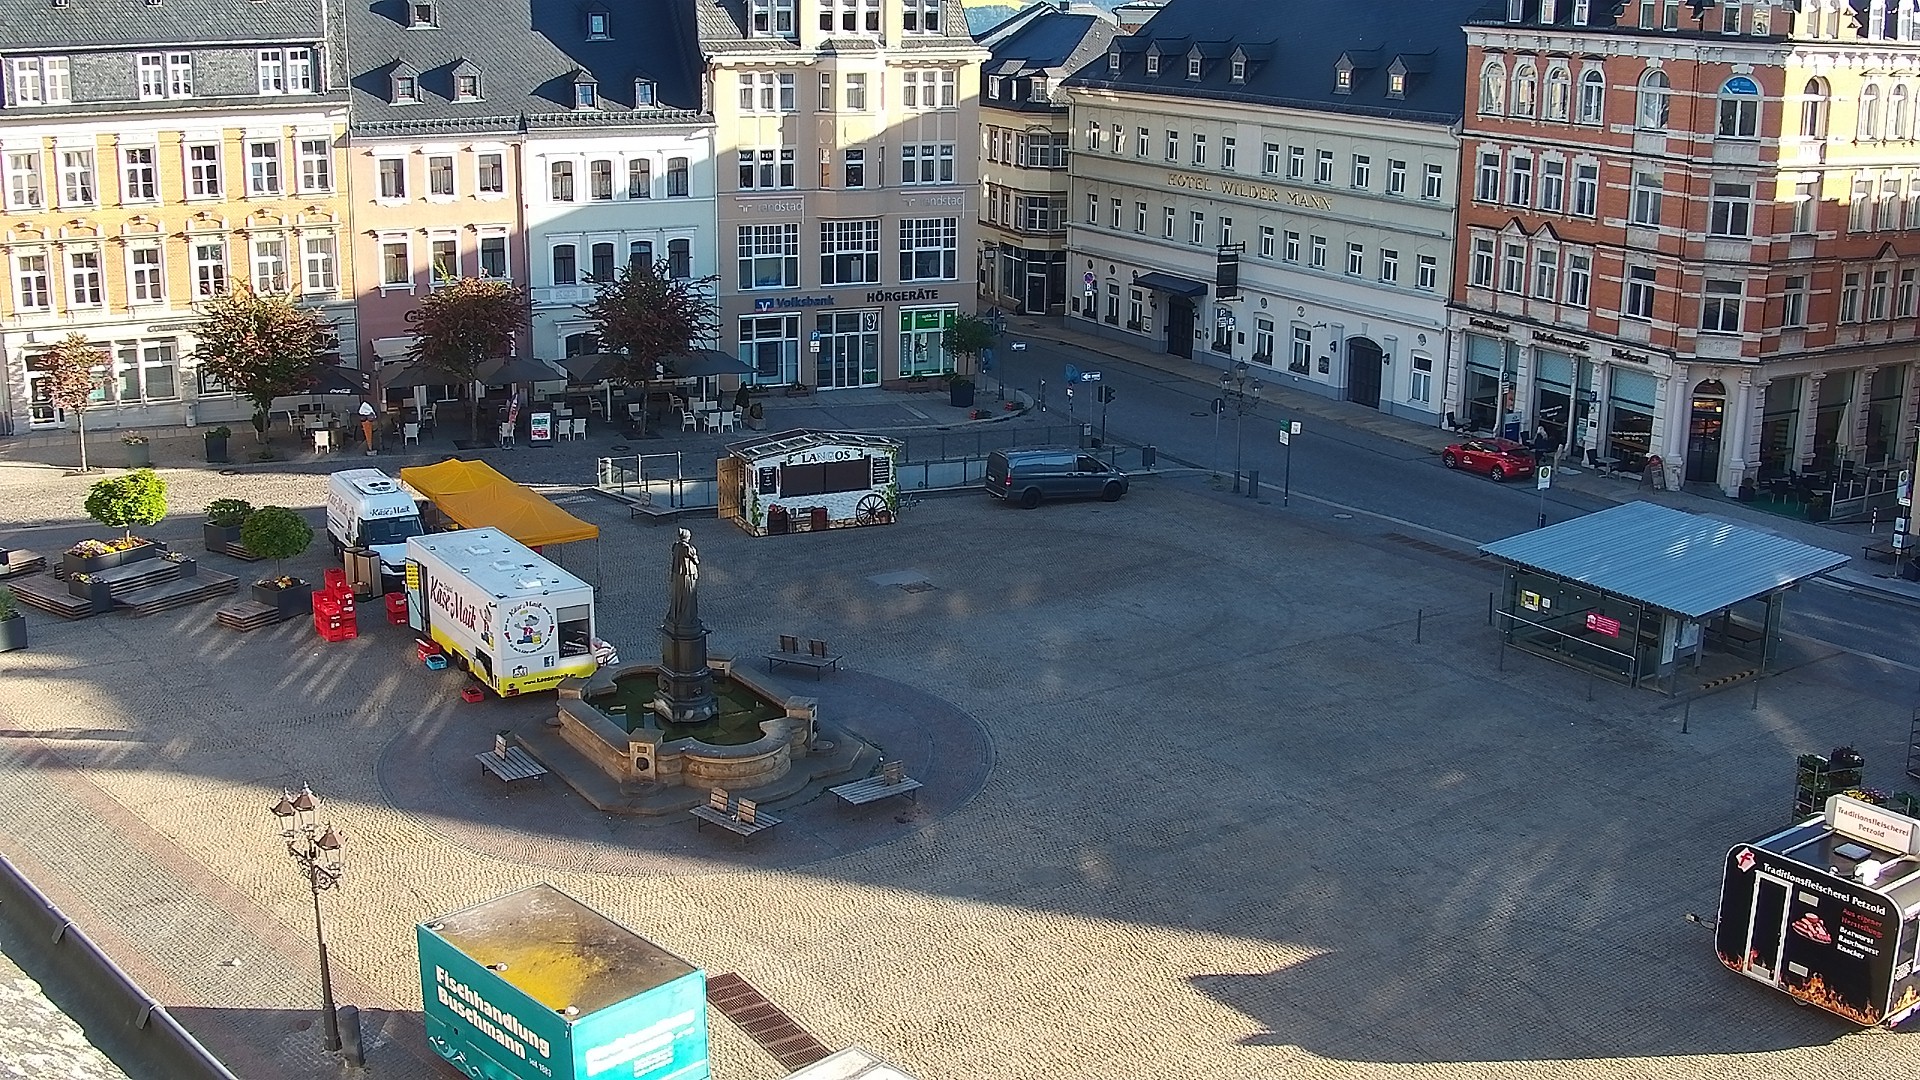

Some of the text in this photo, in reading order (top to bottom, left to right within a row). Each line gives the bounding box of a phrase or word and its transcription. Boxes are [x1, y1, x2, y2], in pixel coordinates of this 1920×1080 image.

[1167, 173, 1333, 211] HOTEL WILDER MANN
[757, 200, 802, 212] randstad
[776, 295, 835, 308] Volksbank
[866, 289, 939, 303] HÖRGERÄTE
[801, 450, 851, 463] LANGOS
[430, 576, 450, 612] Käse
[454, 592, 476, 632] Maik
[1837, 806, 1910, 837] Traditionsfleischerei
[1858, 823, 1885, 838] Petzold
[1763, 862, 1886, 916] Traditionsfleischerei Petzold
[1839, 926, 1874, 945] Bratwurst
[435, 964, 551, 1059] Fischhandlung
[437, 985, 526, 1060] Buschmann
